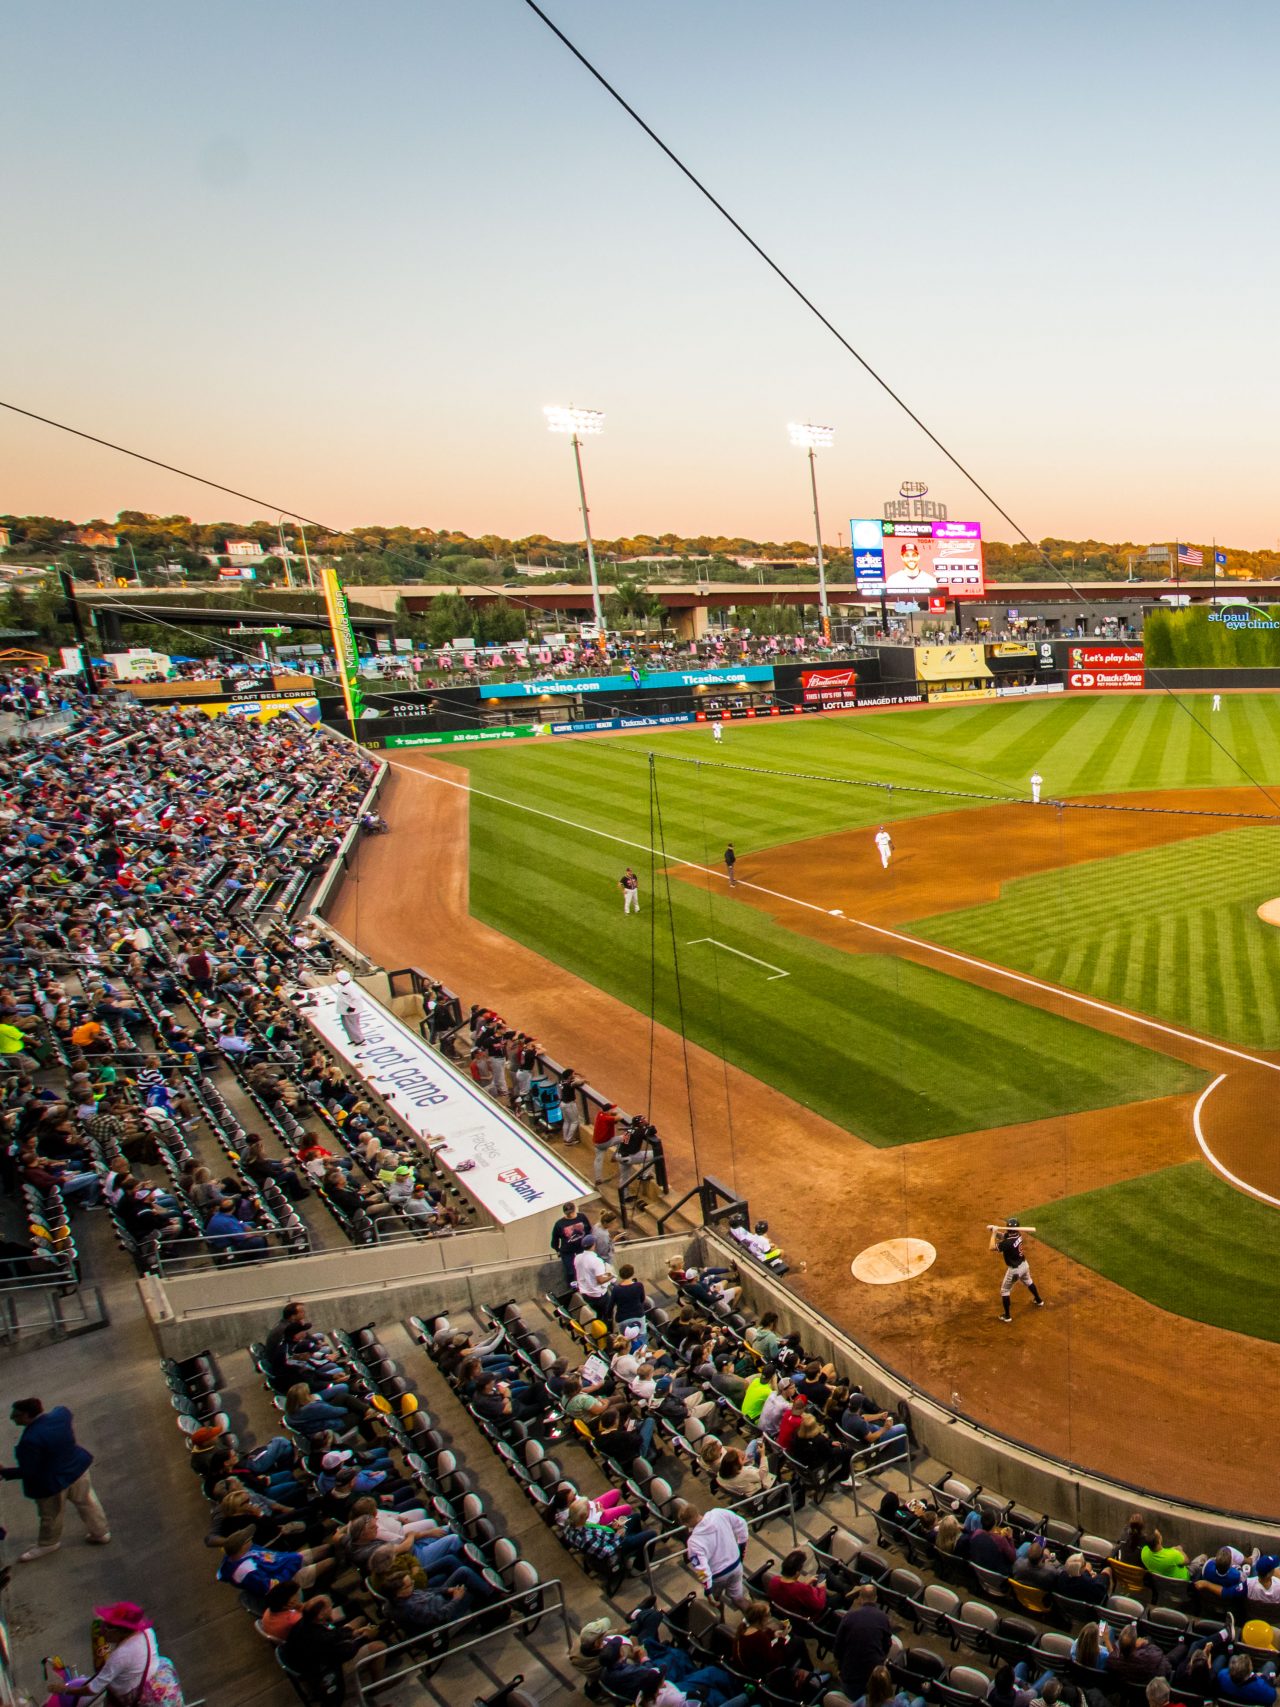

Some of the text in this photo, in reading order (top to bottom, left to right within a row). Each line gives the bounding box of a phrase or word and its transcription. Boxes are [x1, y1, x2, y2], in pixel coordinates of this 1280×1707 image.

[902, 481, 926, 492] CHS
[884, 500, 947, 520] CHS FIELD
[335, 590, 356, 668] Minnesota Corn
[1226, 618, 1280, 630] eye clinic
[1084, 653, 1103, 662] Let's
[1105, 654, 1123, 663] play
[810, 677, 849, 687] Budweiser
[858, 697, 890, 706] MANAGED
[229, 703, 261, 715] SPLASH
[393, 704, 426, 712] GOOSE
[354, 1046, 417, 1069] got
[377, 1068, 449, 1107] game
